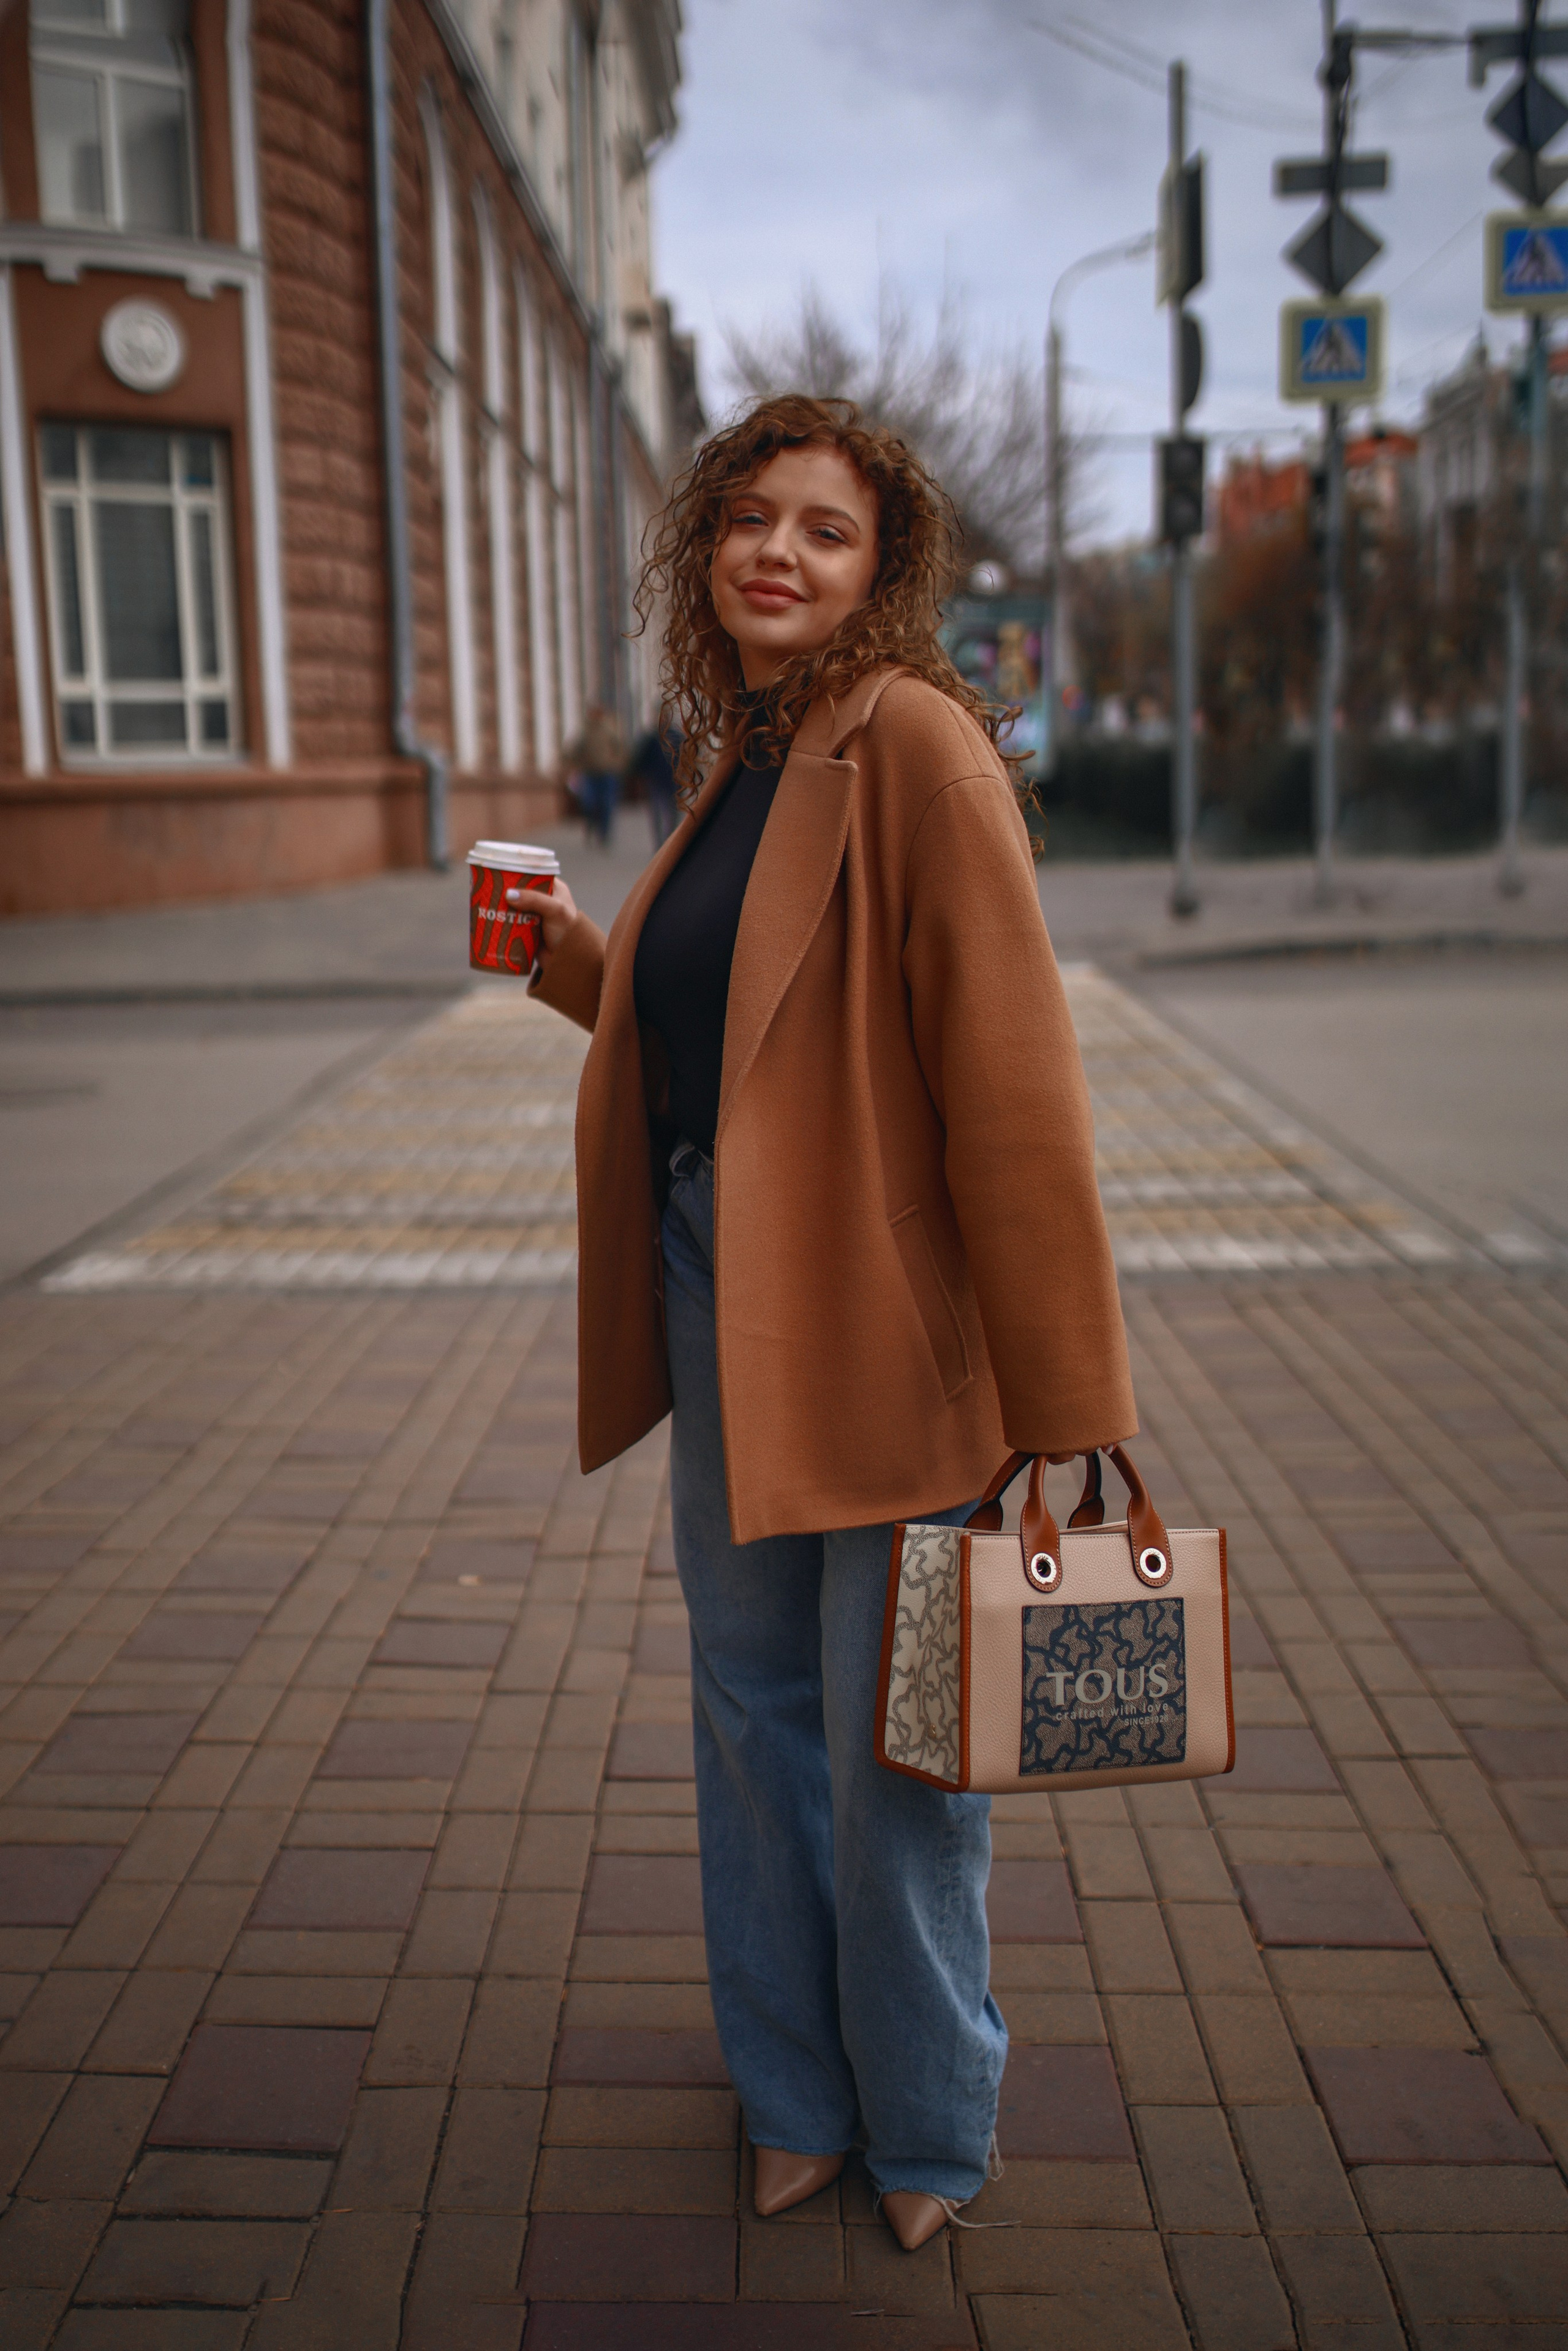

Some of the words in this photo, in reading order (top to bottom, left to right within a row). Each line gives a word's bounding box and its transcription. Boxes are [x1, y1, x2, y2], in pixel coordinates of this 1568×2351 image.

[1046, 1664, 1169, 1705] TOUS
[1056, 1707, 1104, 1721] crafted
[1110, 1704, 1136, 1716] with
[1142, 1702, 1169, 1714] love
